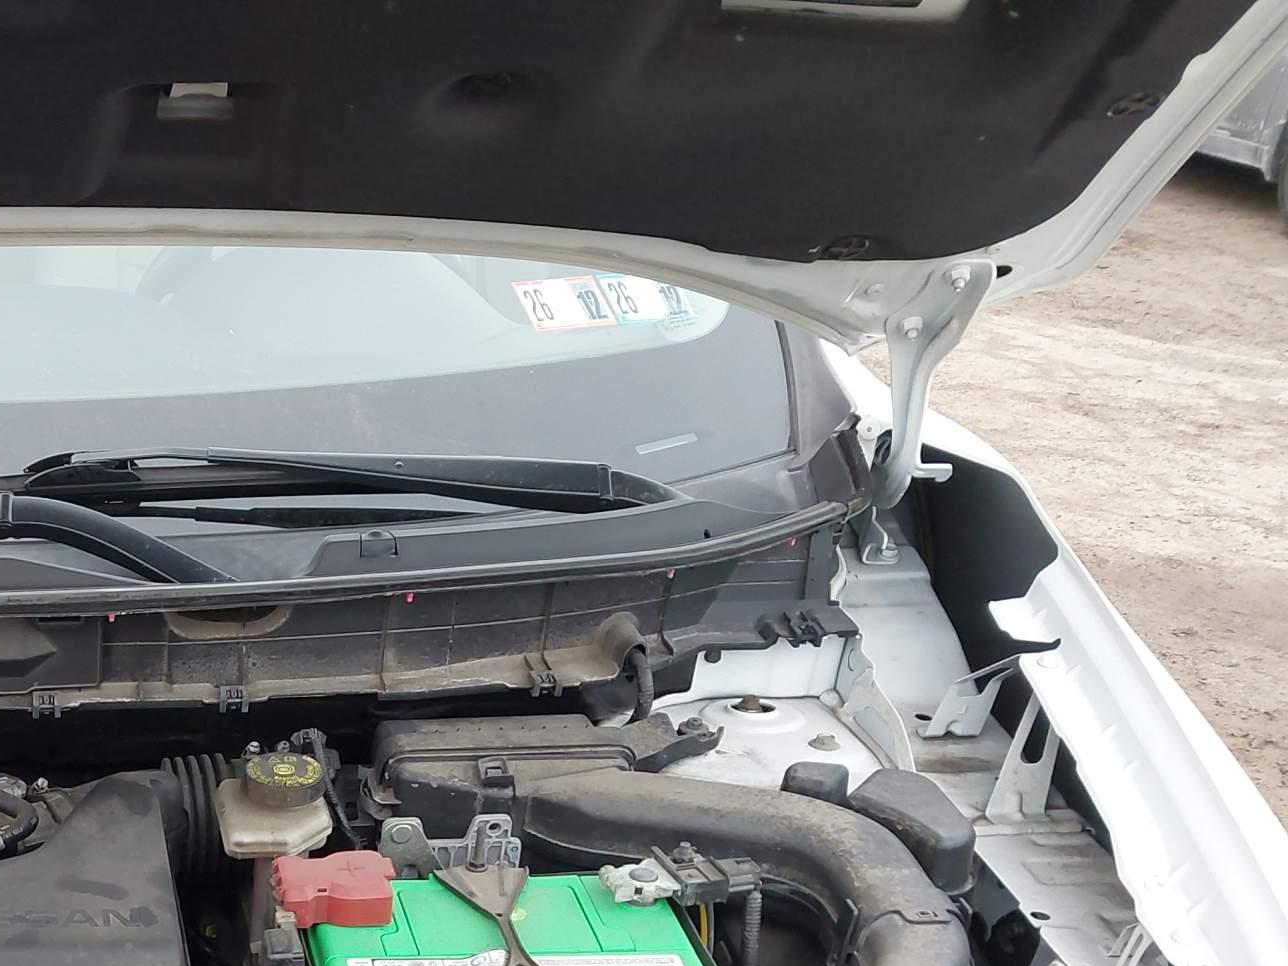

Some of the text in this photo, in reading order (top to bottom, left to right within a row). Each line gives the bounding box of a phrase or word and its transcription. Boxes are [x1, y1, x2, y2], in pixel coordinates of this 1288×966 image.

[523, 289, 609, 322] 26 12
[607, 282, 684, 314] 26 12
